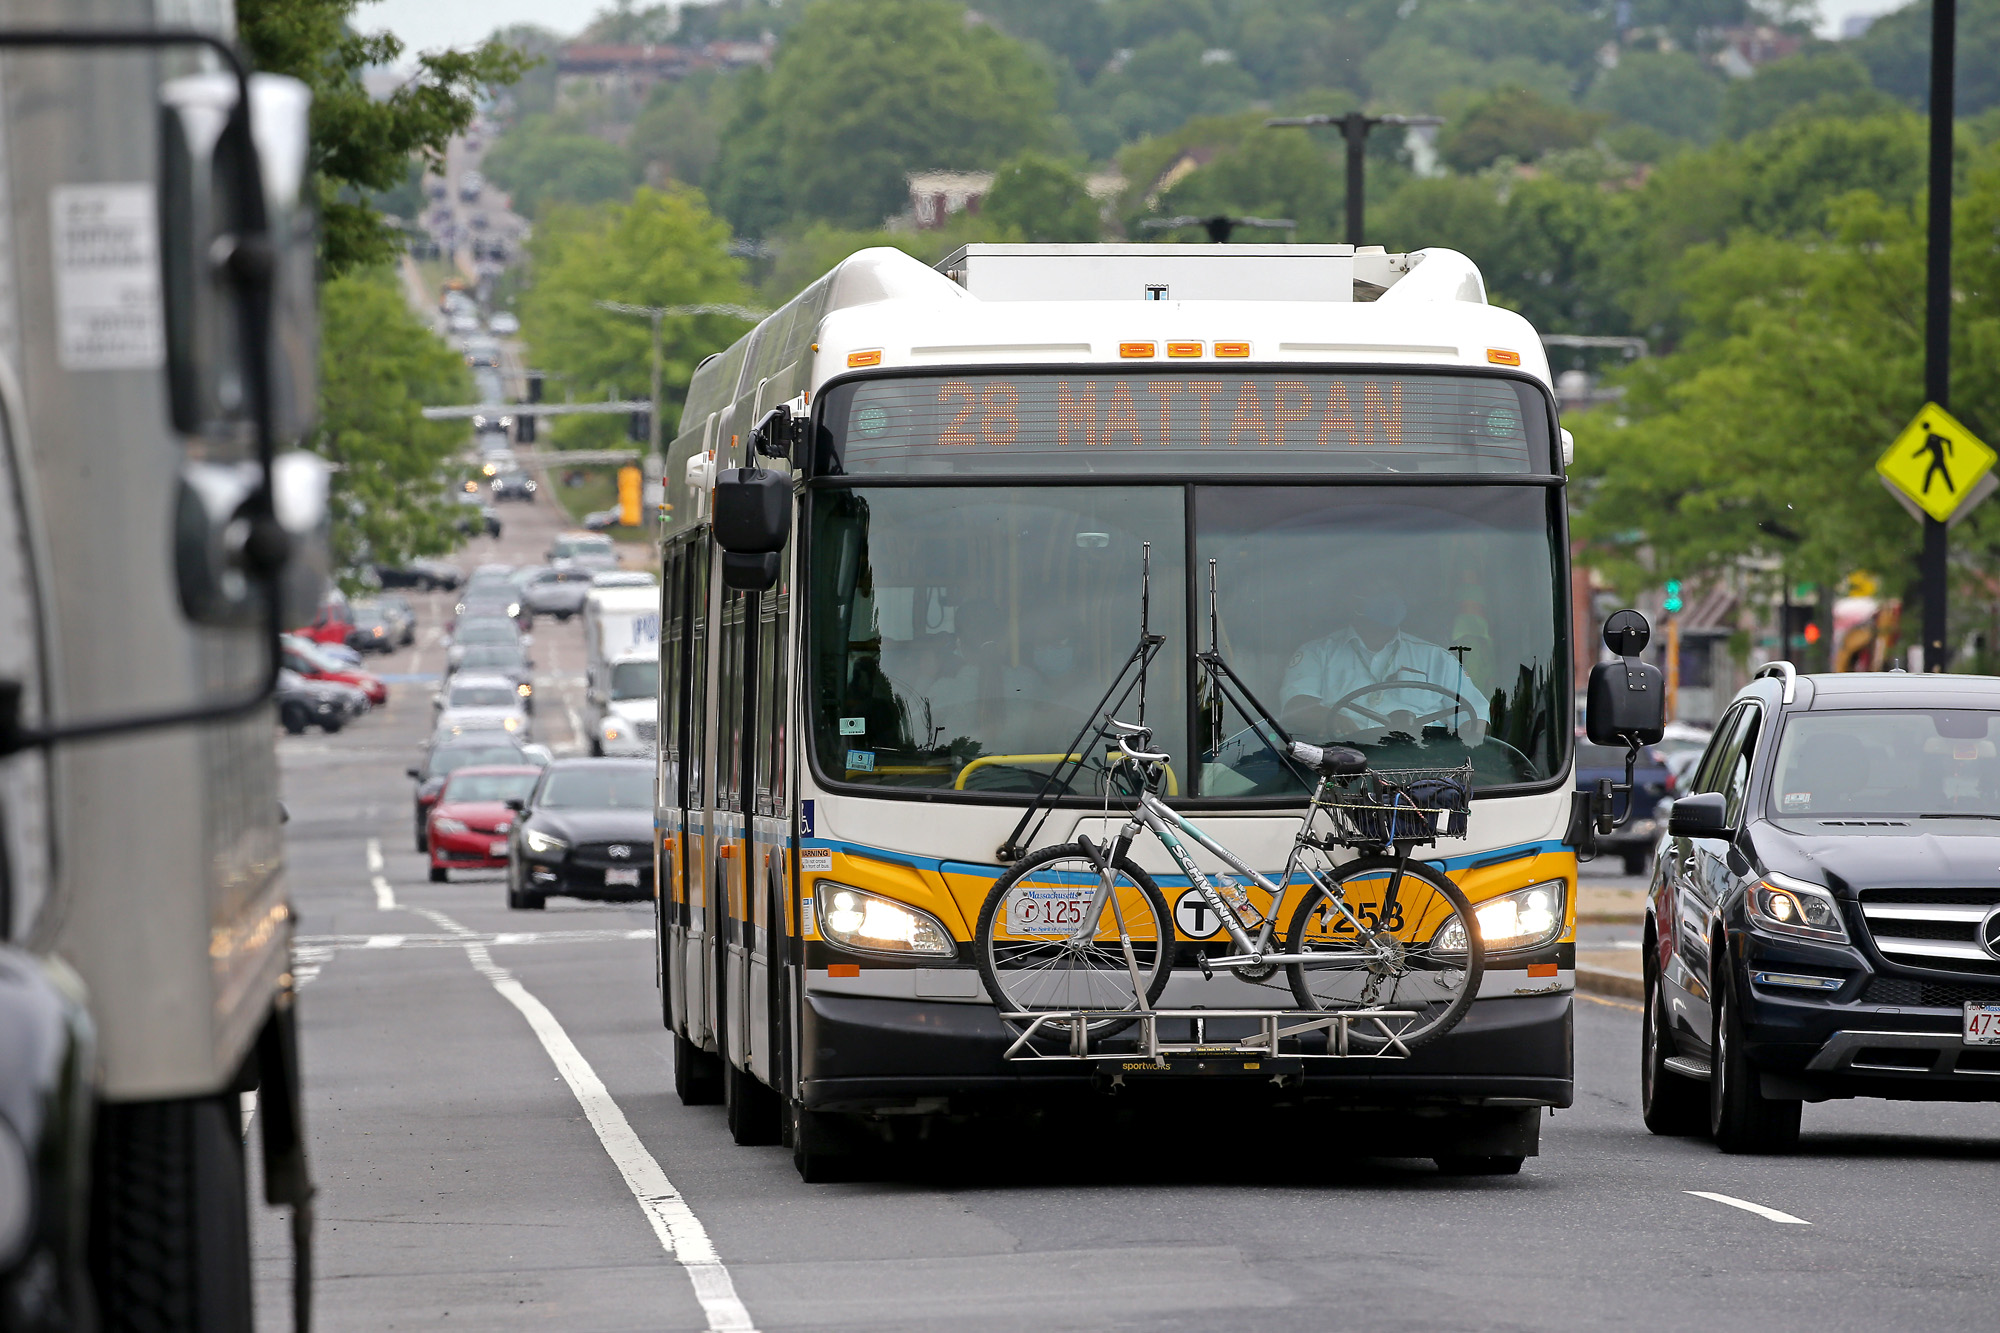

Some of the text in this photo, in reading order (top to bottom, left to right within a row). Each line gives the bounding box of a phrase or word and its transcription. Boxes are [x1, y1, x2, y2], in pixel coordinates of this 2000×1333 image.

[938, 381, 1401, 446] 28 MATTAPAN
[1028, 891, 1079, 900] Massachusetts
[1172, 844, 1240, 931] SCHWINN
[1183, 901, 1211, 931] T
